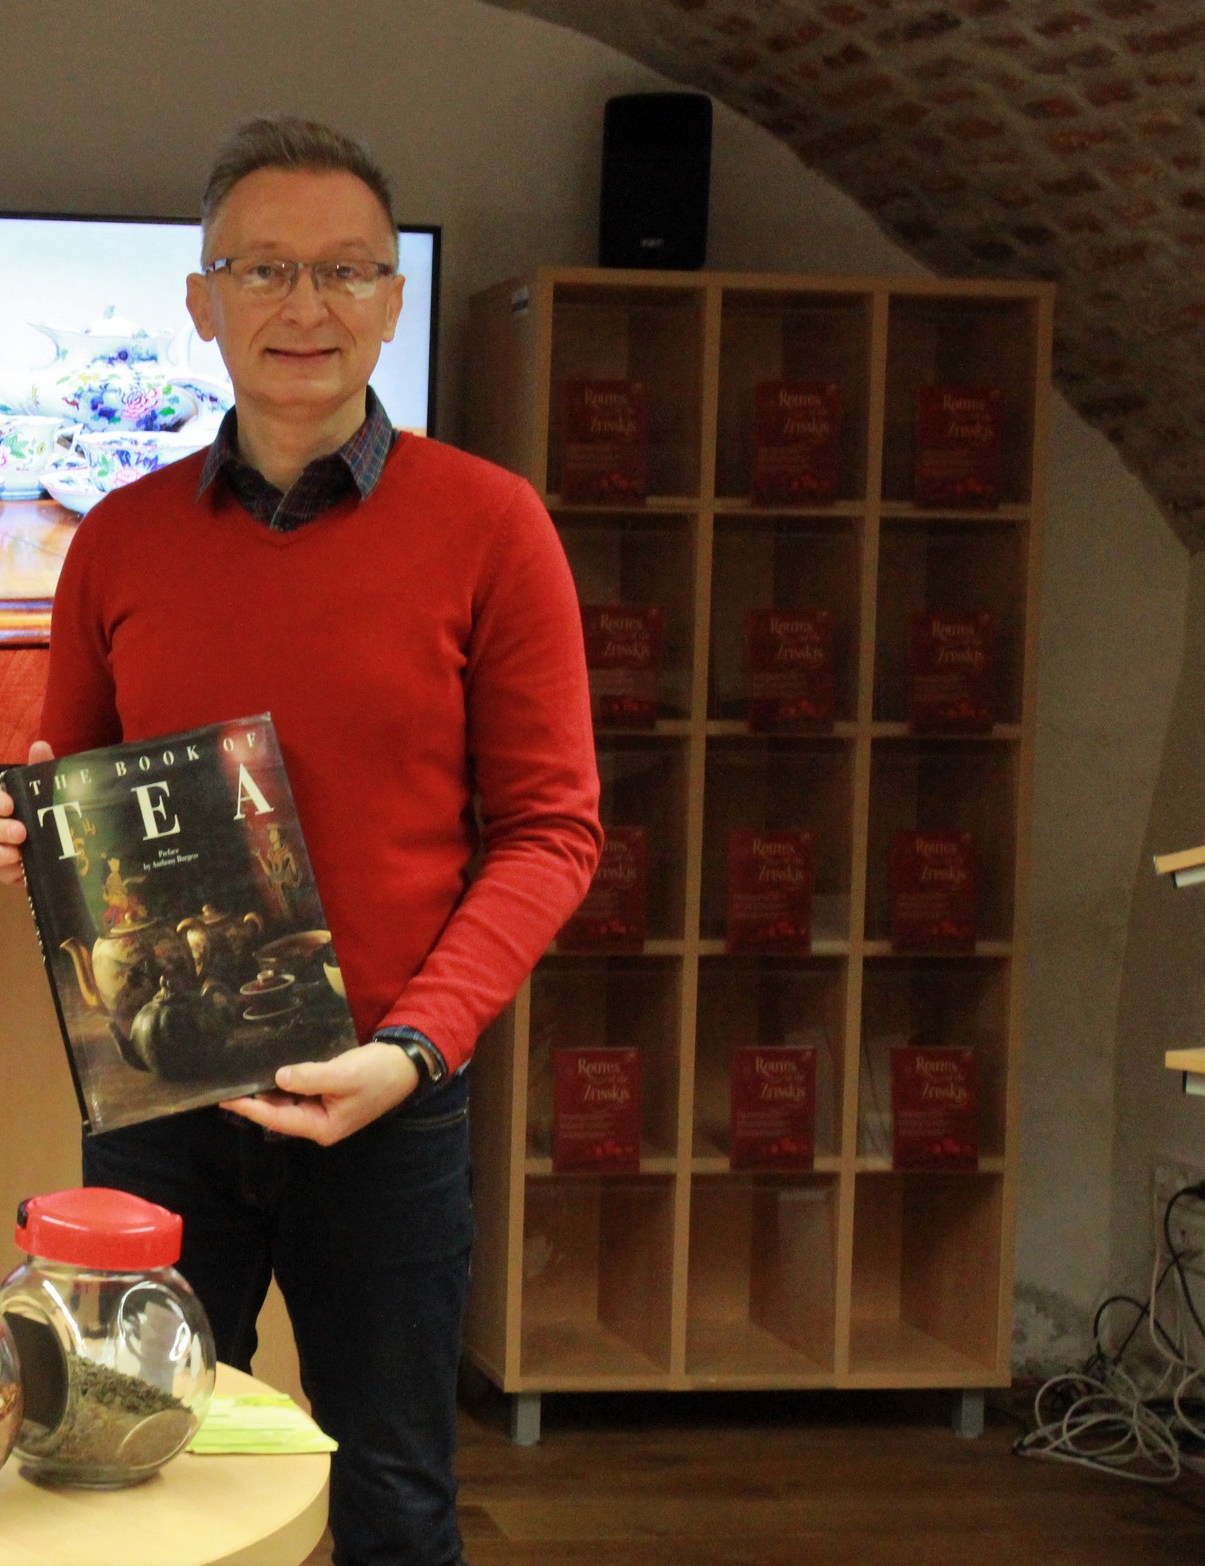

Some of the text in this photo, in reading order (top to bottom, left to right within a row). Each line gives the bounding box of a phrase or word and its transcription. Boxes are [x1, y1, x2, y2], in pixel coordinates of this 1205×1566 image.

[29, 731, 258, 797] THE BOOK OF
[37, 762, 275, 861] TEA
